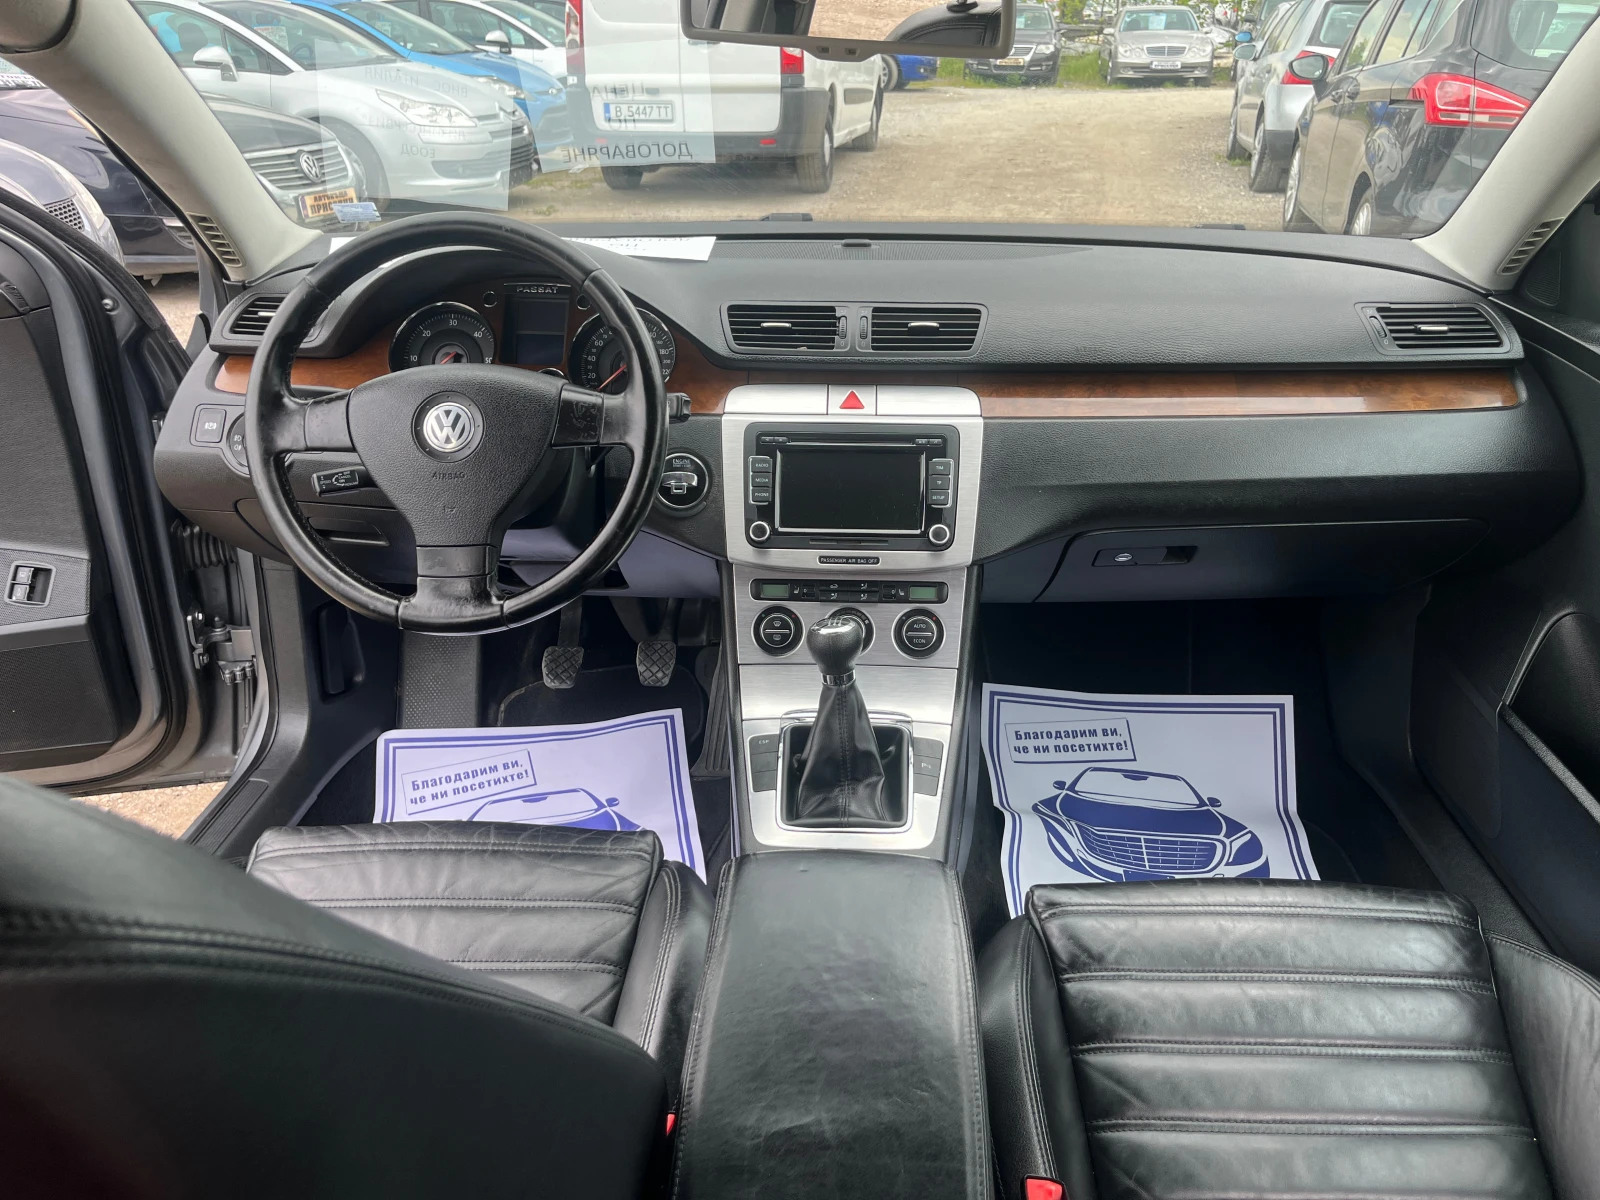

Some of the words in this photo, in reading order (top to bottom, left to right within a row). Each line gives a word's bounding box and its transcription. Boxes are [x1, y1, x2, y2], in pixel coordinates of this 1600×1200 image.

[516, 285, 559, 294] PASSAT
[432, 471, 466, 480] AIRBAG
[1014, 728, 1098, 741] Благодарим
[1101, 727, 1122, 738] ви,
[1013, 745, 1030, 754] че
[1033, 745, 1050, 754] ни
[1053, 740, 1129, 753] посетихте!
[412, 765, 499, 791] Благодарим
[410, 795, 427, 805] че
[431, 790, 448, 801] ни
[453, 769, 529, 796] посетихте!
